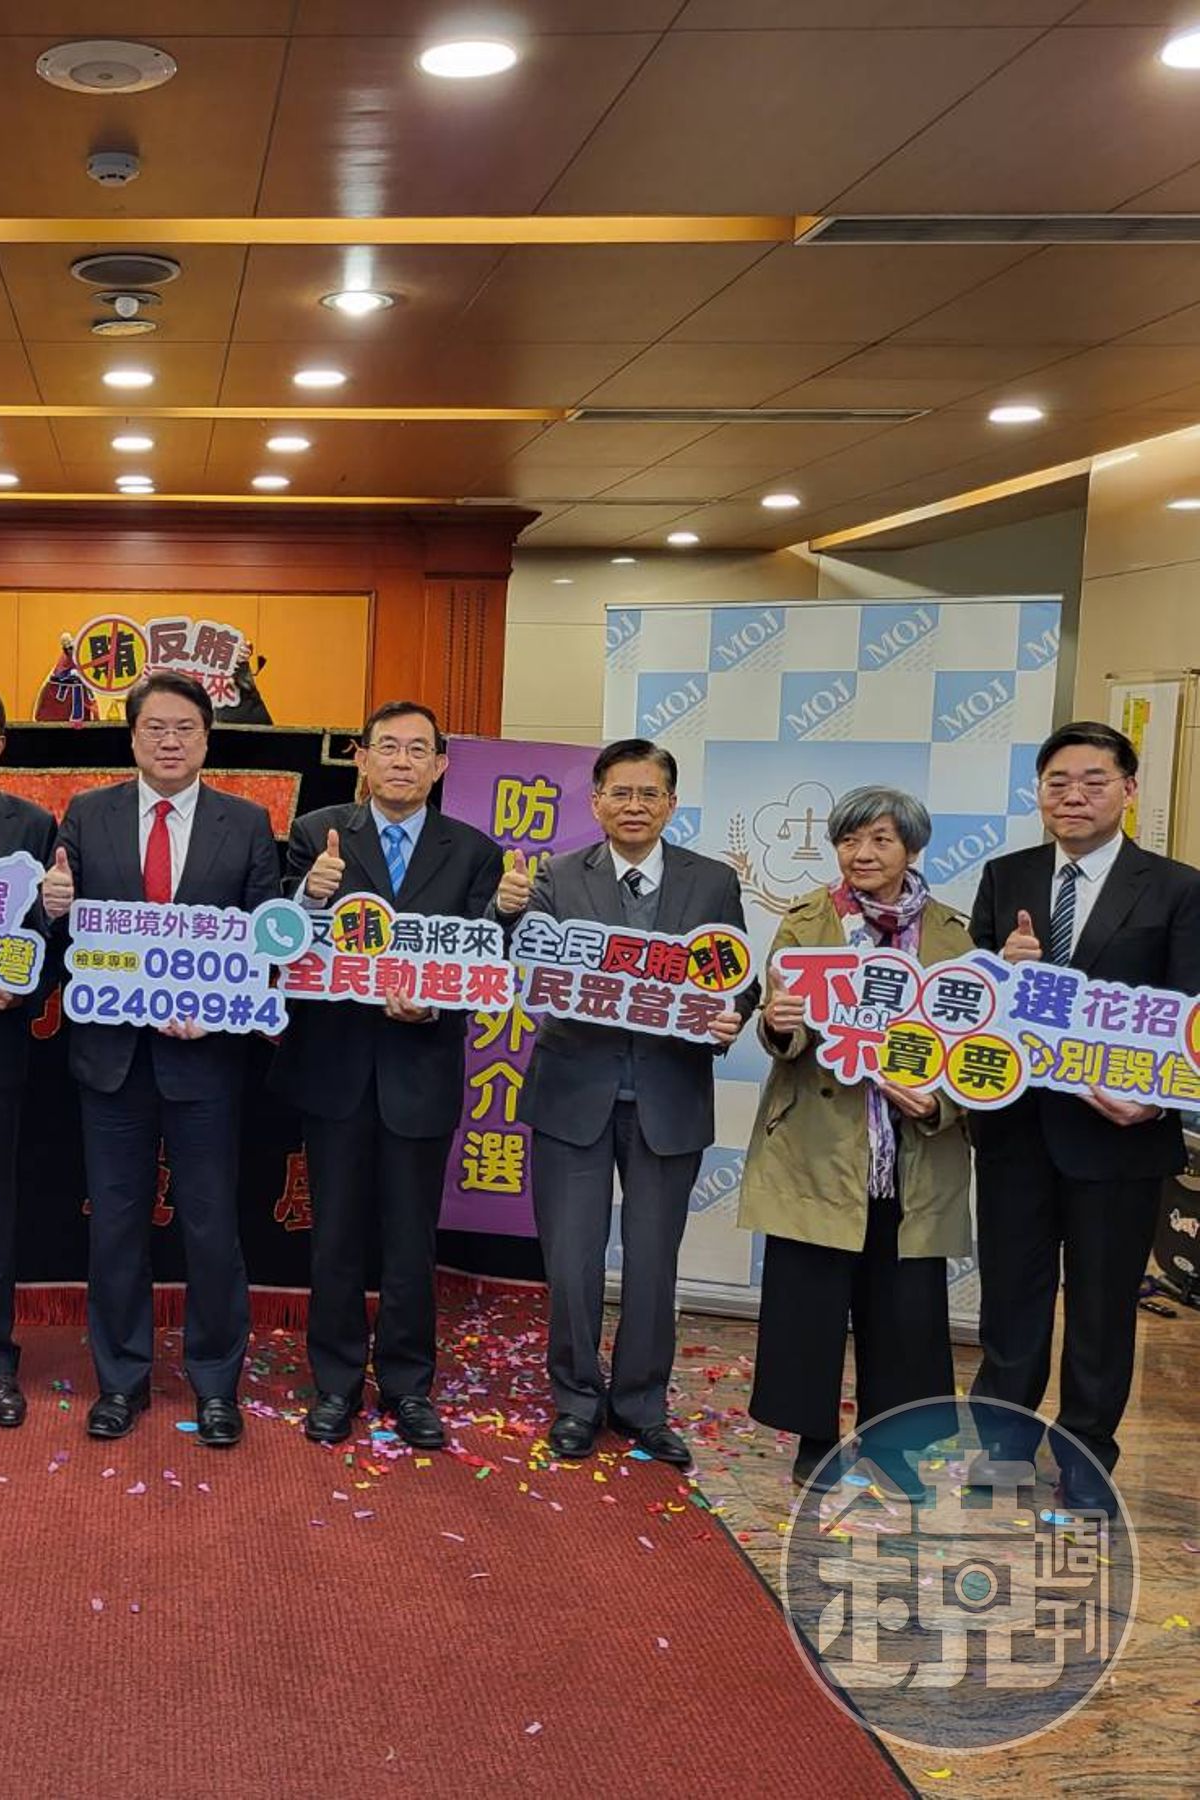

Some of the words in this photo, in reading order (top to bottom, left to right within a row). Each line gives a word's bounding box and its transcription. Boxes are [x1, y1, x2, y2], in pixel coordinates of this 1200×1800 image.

[150, 622, 239, 670] 反賄
[606, 612, 636, 649] OJ
[714, 609, 779, 665] MOJ
[865, 608, 933, 664] MOJ
[642, 678, 702, 734] MOJ
[785, 678, 850, 736] MOJ
[938, 677, 1010, 736] MOJ
[664, 812, 695, 845] OJ
[931, 823, 1000, 879] MOJ
[76, 907, 248, 942] 阻絕境外勢力
[144, 948, 259, 984] 0800-
[284, 952, 508, 1006] 全民動起來
[780, 954, 986, 1026] 不買票
[70, 984, 281, 1028] 024099#4
[525, 966, 726, 1036] 民眾當家
[833, 1004, 892, 1031] NO!
[971, 957, 1181, 1038] 選花招
[823, 1025, 1011, 1093] 不賣票
